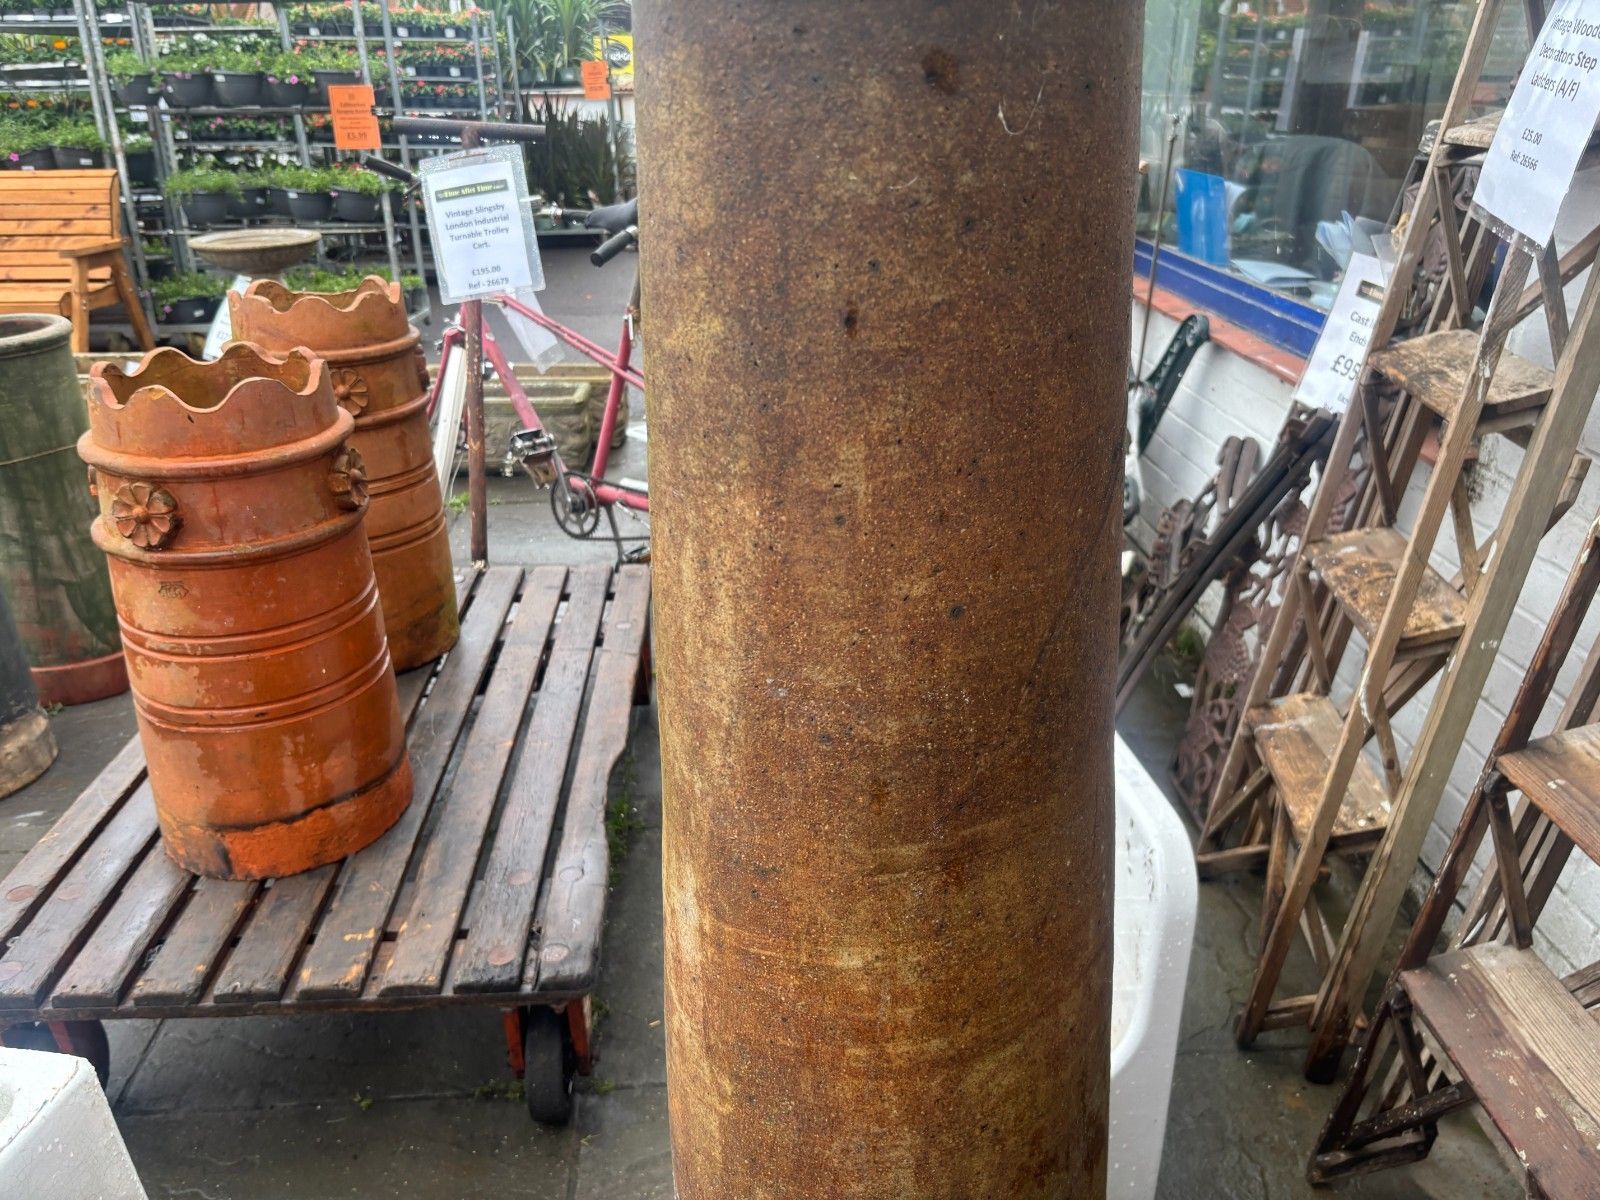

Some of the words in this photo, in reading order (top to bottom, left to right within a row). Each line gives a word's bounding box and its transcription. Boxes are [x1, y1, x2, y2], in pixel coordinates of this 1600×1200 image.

[1539, 42, 1575, 65] Decorators
[1574, 51, 1598, 74] Step
[1531, 71, 1557, 92] Ladders
[1555, 77, 1581, 102] (A/F)
[1521, 127, 1543, 146] £25.00
[1519, 154, 1539, 171] 26566
[445, 208, 474, 220] Vintage
[475, 203, 505, 214] Slingsby
[445, 220, 474, 231] London
[475, 214, 510, 226] Industrial
[449, 230, 483, 242] Turnable
[483, 226, 510, 236] Trolley
[472, 241, 491, 250] Cart.
[472, 265, 502, 276] £195.00
[468, 280, 481, 290] Ref
[1350, 310, 1370, 327] Cast
